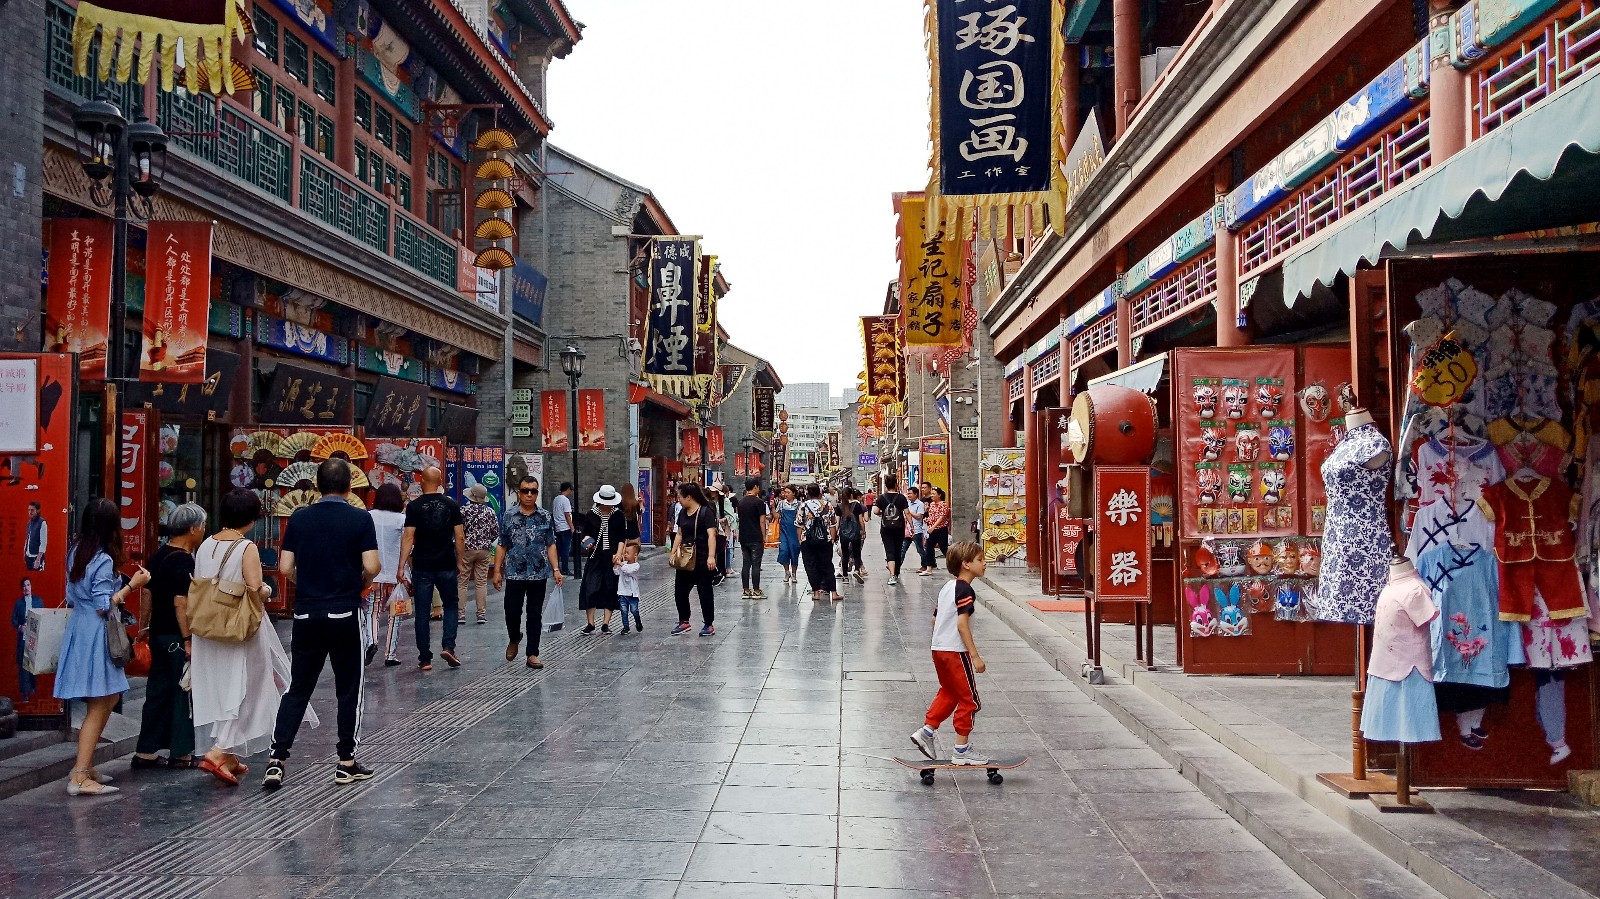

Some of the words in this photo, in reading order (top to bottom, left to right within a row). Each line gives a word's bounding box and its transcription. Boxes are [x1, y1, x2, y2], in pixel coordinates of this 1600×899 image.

[955, 0, 1036, 162] 琢国画
[957, 165, 1032, 179] 工作室
[918, 209, 950, 337] 星记扇子
[907, 277, 921, 331] 厂家直销
[949, 276, 963, 331] 专卖店
